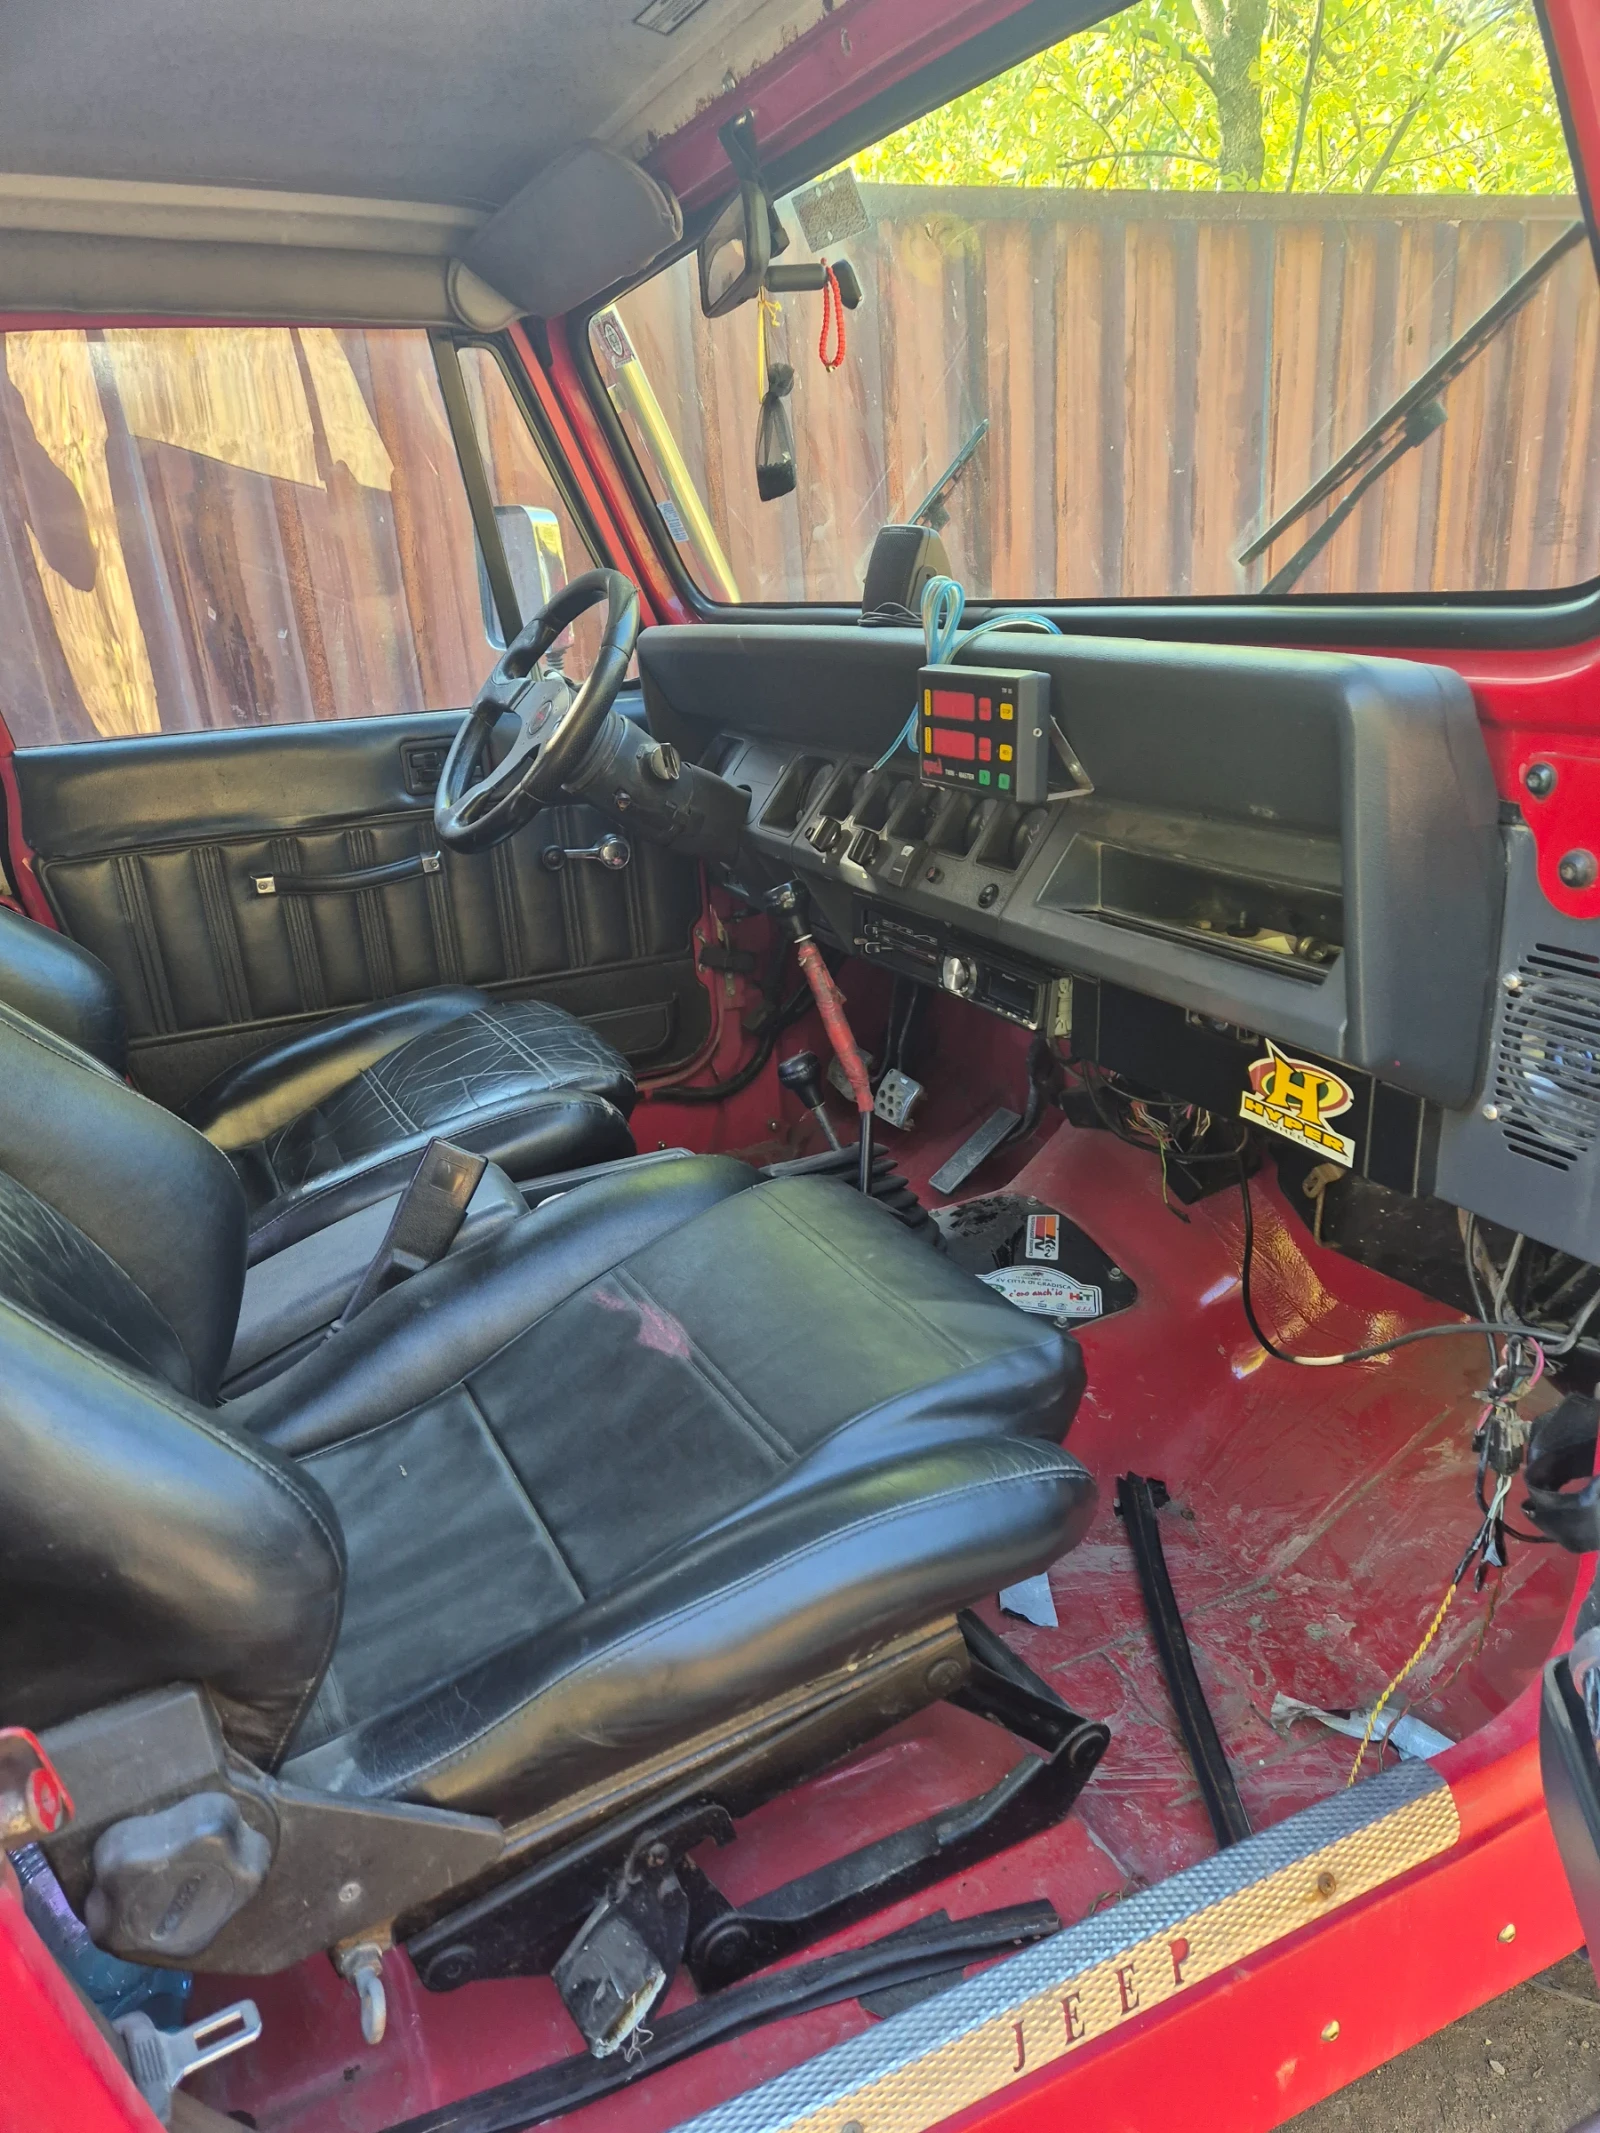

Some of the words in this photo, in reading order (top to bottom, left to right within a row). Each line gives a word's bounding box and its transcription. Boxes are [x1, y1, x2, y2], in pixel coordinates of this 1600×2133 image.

[1263, 1046, 1331, 1132] H
[1244, 1096, 1350, 1158] HYPER
[1265, 1120, 1321, 1150] WHEELS
[1037, 1281, 1071, 1290] GRADISCA
[1011, 1937, 1190, 2073] JEEP
